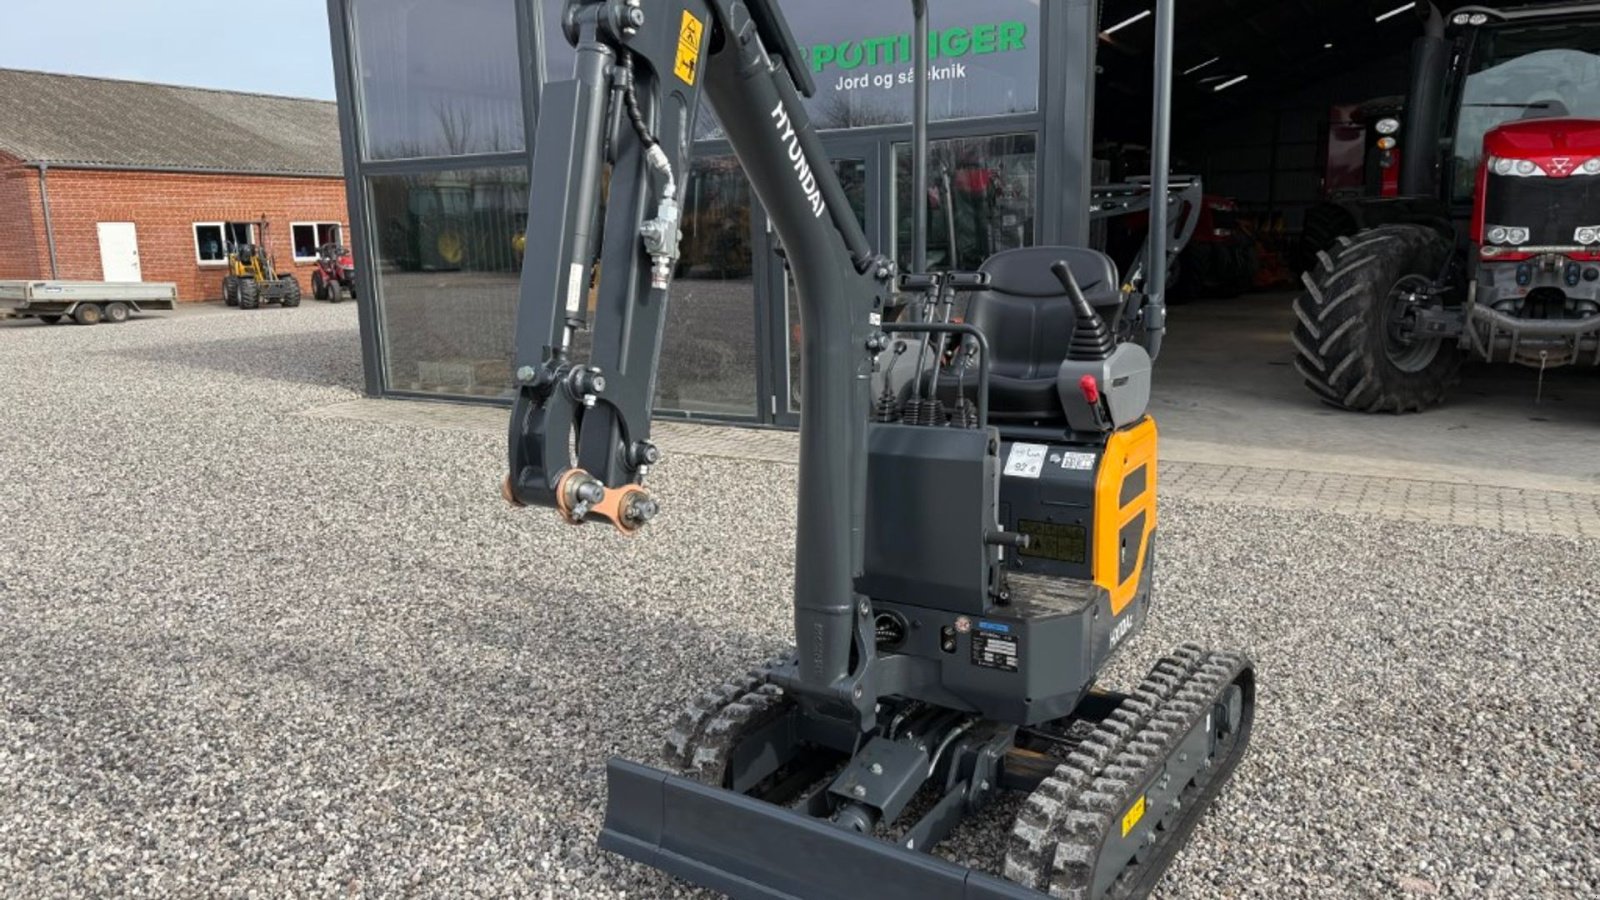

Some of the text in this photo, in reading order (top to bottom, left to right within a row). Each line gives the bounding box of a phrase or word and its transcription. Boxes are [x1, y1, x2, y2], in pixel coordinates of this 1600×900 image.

[835, 72, 869, 91] Jord
[874, 73, 893, 89] og
[771, 100, 825, 218] HYUNDAI
